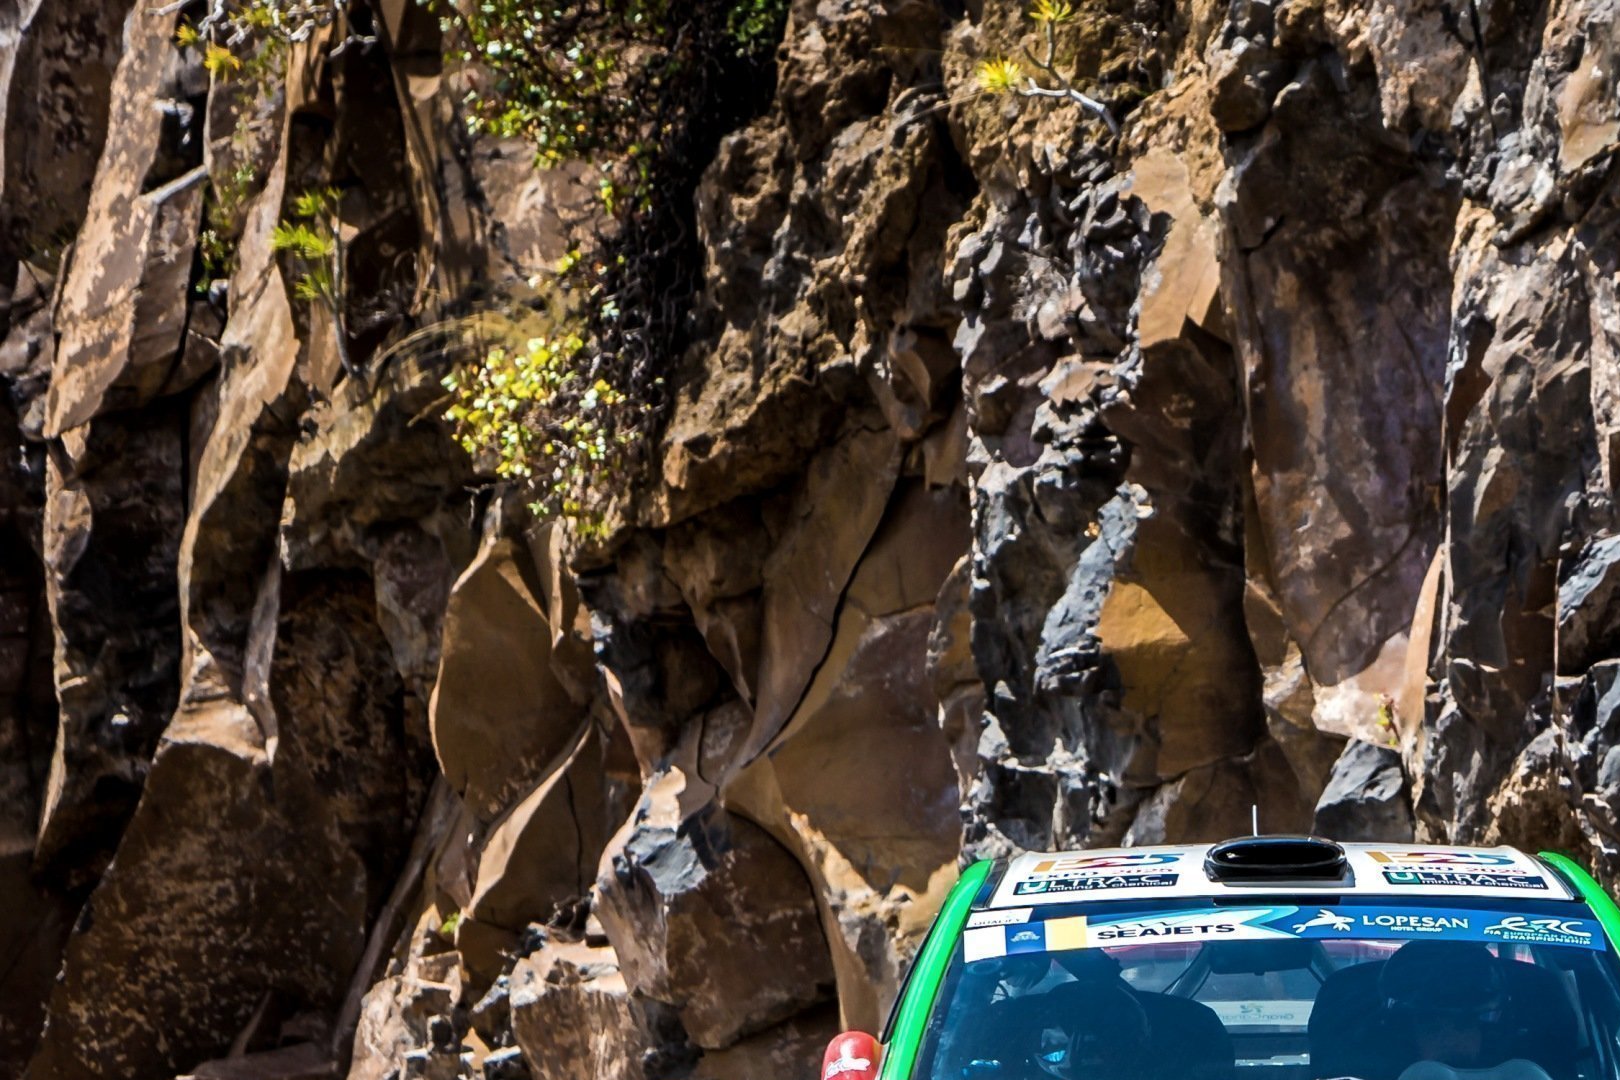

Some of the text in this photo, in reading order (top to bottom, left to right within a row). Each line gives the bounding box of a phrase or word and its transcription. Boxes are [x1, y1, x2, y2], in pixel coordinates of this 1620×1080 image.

[1023, 874, 1162, 894] ULTRA-C
[1389, 871, 1530, 885] ULTRA-C
[1485, 880, 1544, 889] chemical
[1047, 883, 1093, 892] mining
[1111, 880, 1173, 888] chemical
[1362, 914, 1469, 929] LOPESAN
[1097, 923, 1235, 940] SEAJETS
